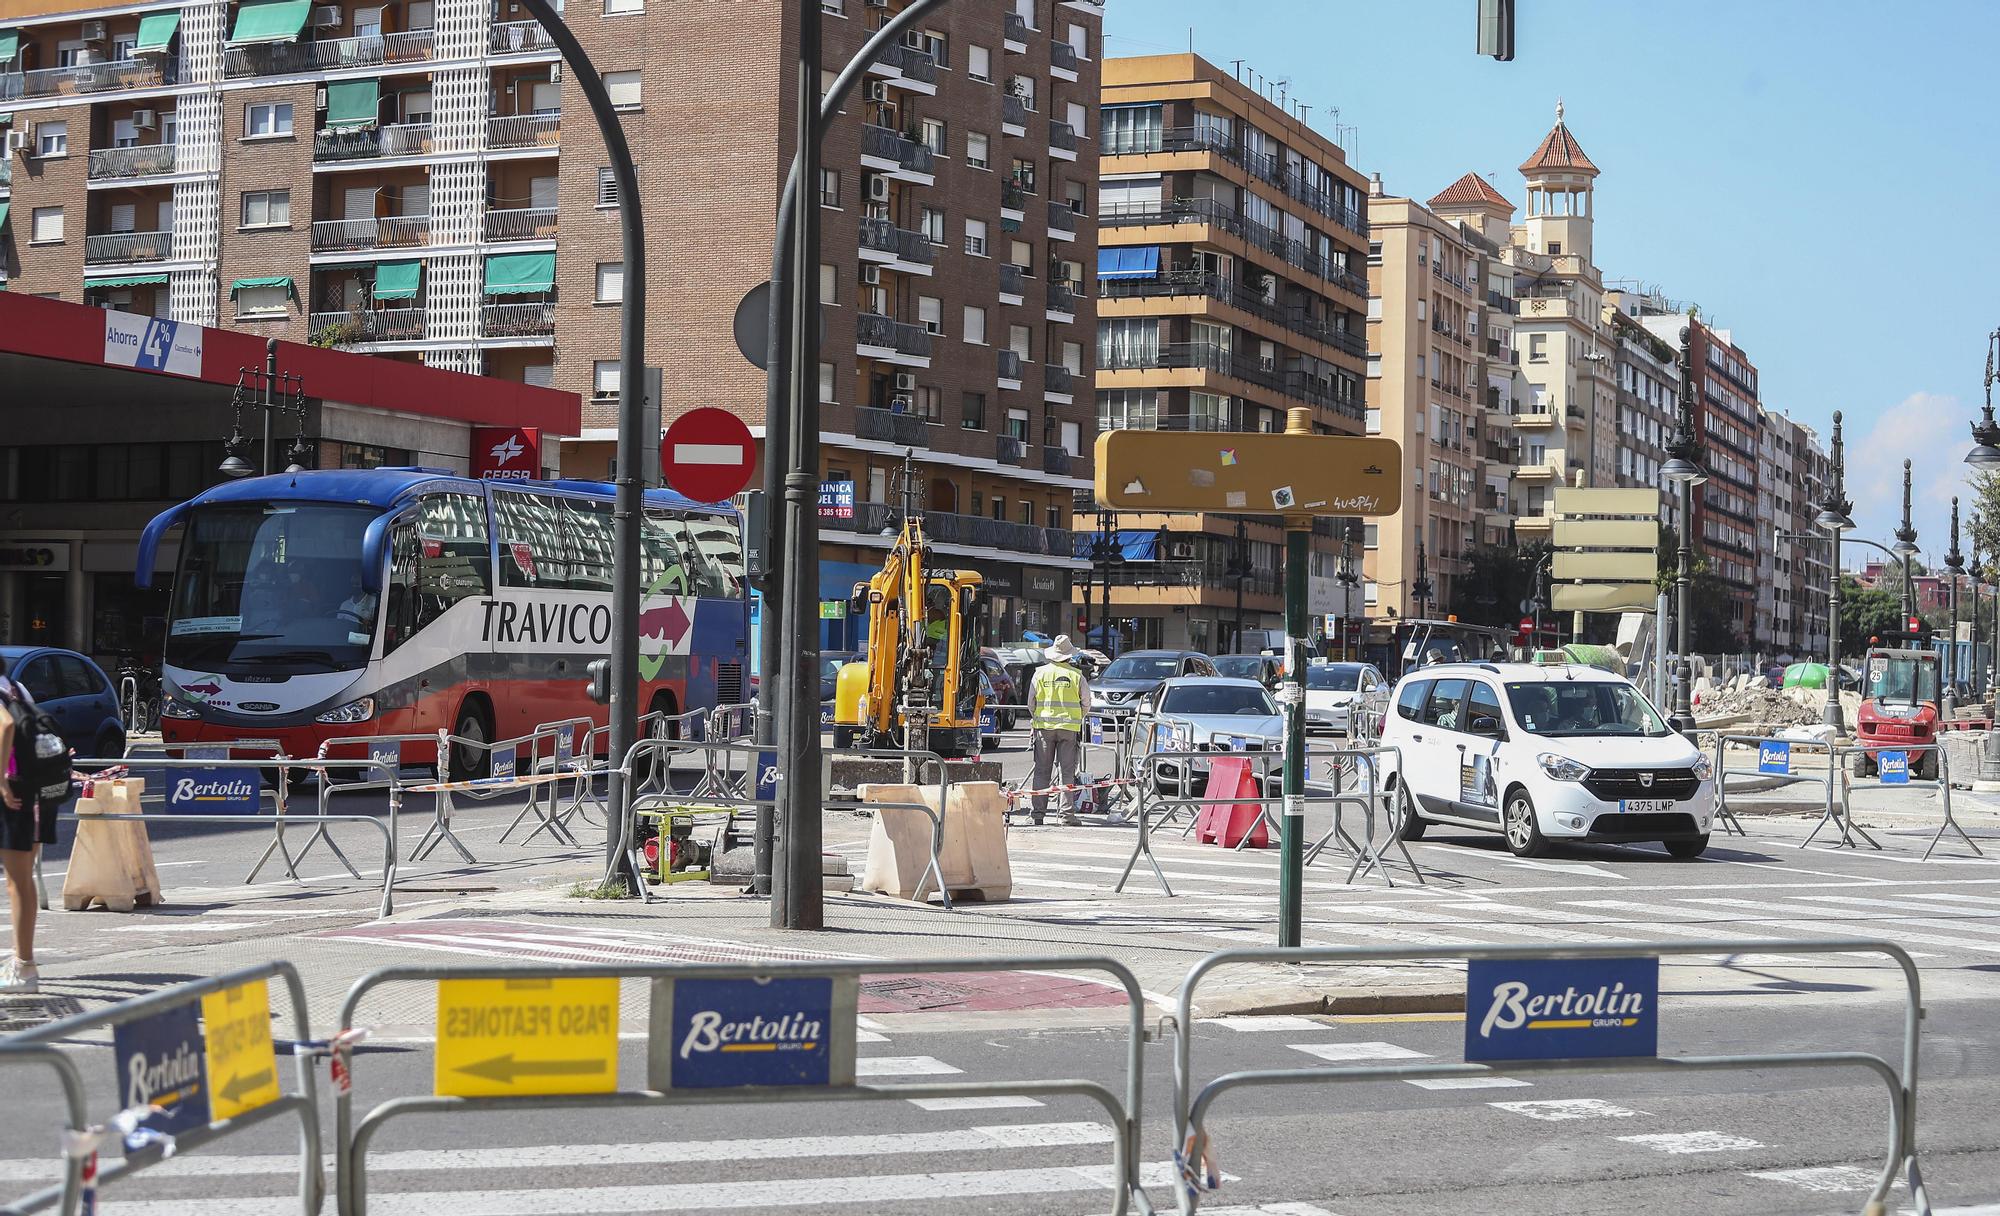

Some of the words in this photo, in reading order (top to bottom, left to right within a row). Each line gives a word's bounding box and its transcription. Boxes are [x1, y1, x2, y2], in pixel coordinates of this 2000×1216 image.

[107, 327, 138, 346] Ahorra
[483, 470, 531, 480] CEPSA
[818, 484, 851, 493] LINICA
[836, 494, 851, 504] PIE
[823, 508, 834, 516] 385
[1872, 671, 1880, 680] 25
[1628, 801, 1653, 811] 4375
[1655, 801, 1674, 811] LMP
[1592, 1018, 1622, 1026] GRUPO
